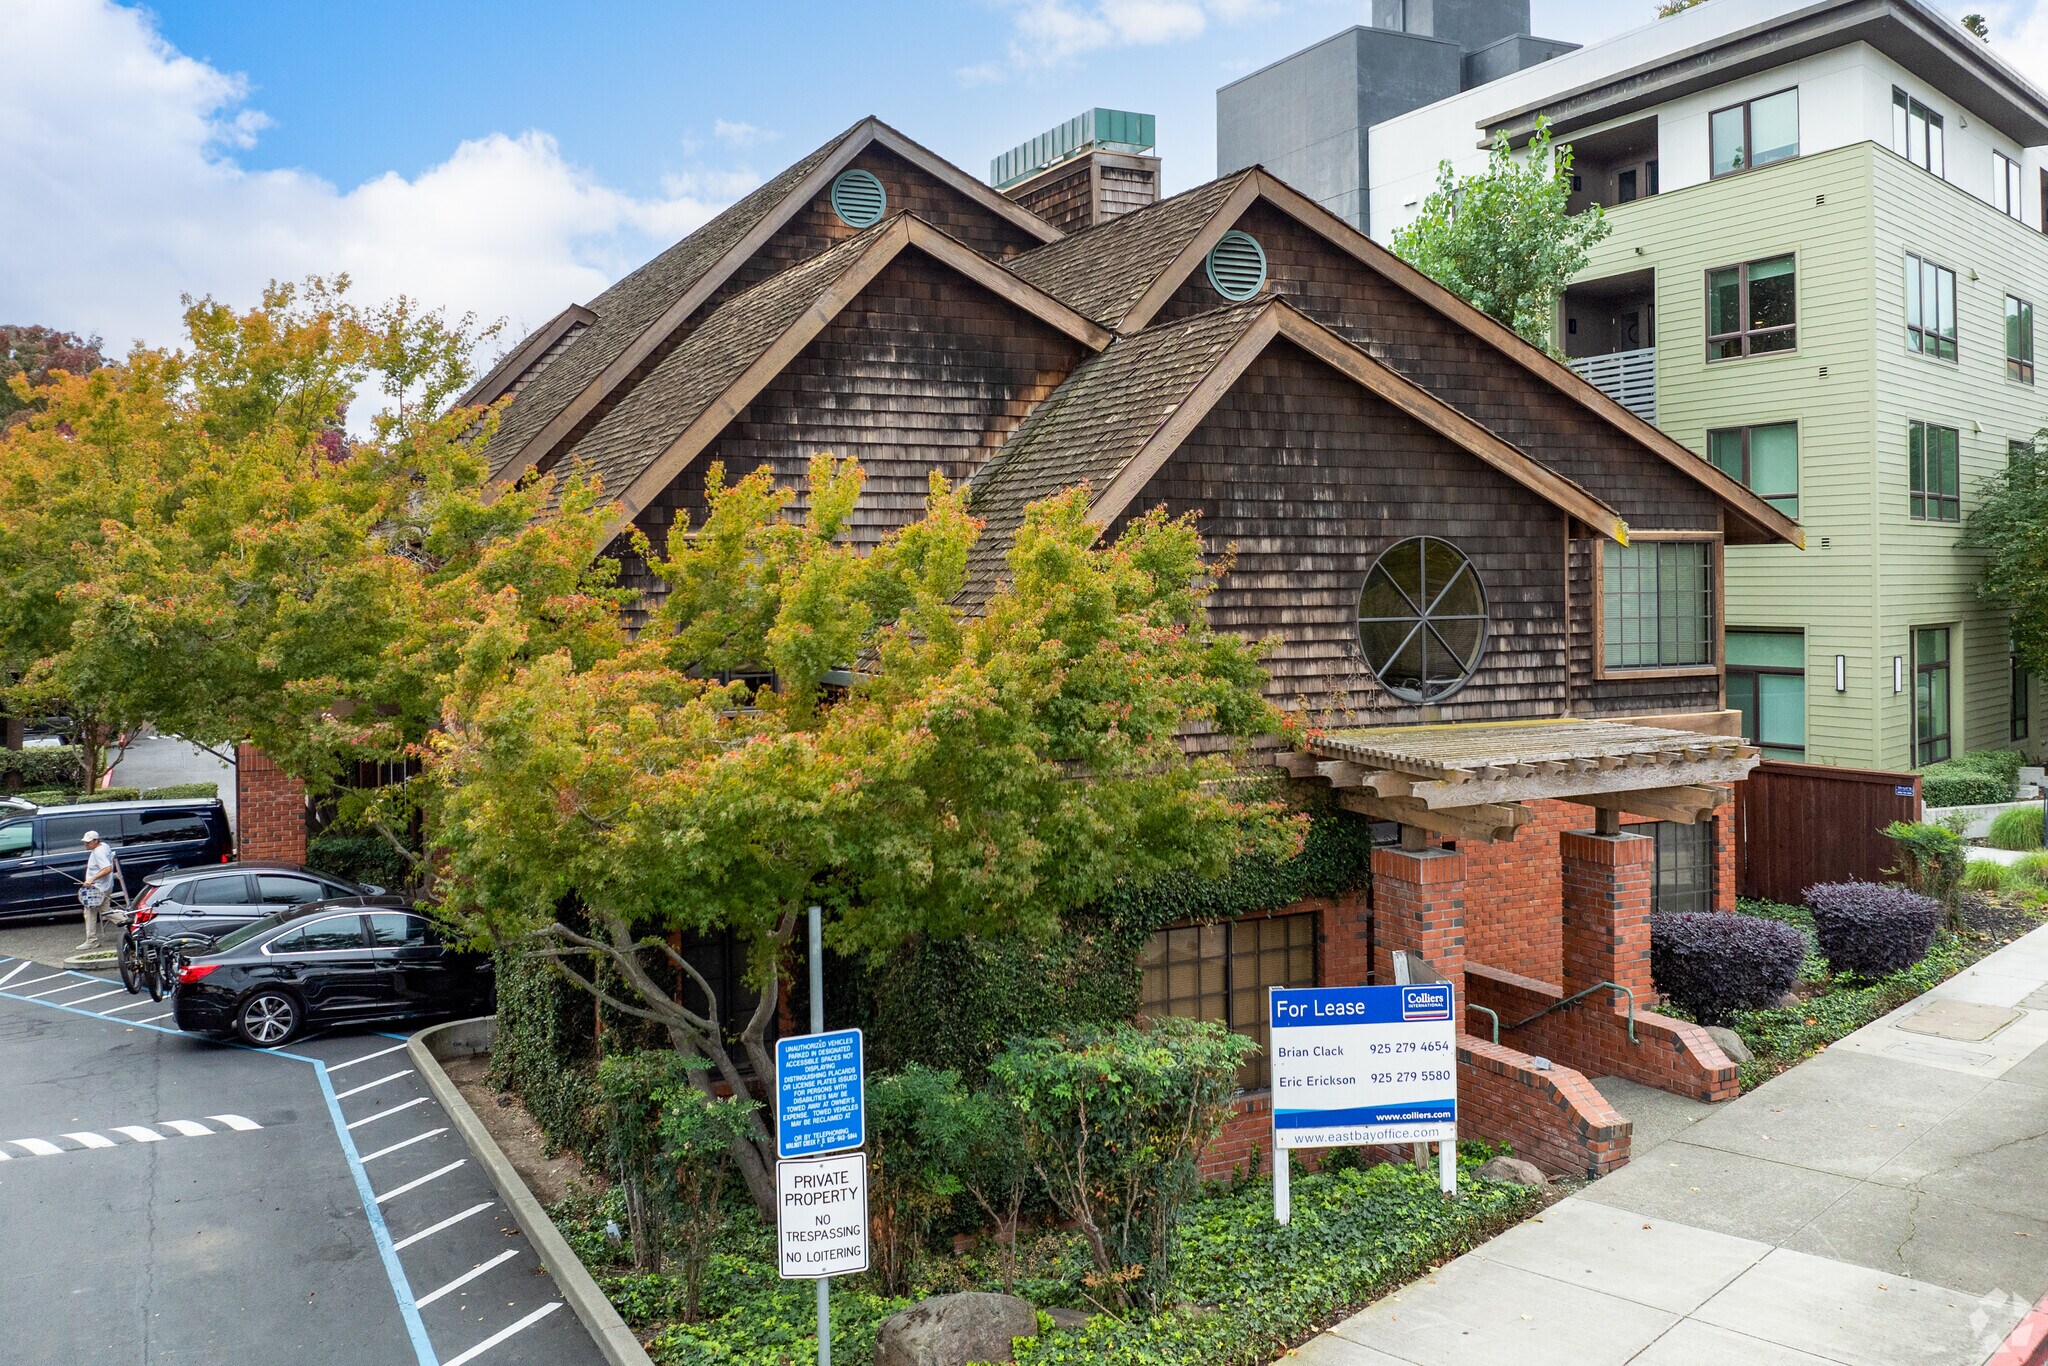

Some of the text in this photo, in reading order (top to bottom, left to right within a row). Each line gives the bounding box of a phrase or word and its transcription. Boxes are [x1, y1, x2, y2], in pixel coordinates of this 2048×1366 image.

[1408, 993, 1444, 1003] Colliers
[1277, 1000, 1365, 1017] For Lease
[785, 1038, 853, 1052] UNAUTHORIZED VEHICLES
[818, 1045, 850, 1055] DESIGNATED
[1279, 1041, 1449, 1058] Brian Clack 925 279 4654
[786, 1058, 818, 1067] ACCESSIBLE
[821, 1054, 841, 1063] SPACES
[805, 1063, 835, 1072] DISPLAYING
[784, 1067, 855, 1083] DISTINGUISHING PLACARDS
[1280, 1070, 1450, 1087] Eric Erickson 925 279 5580
[793, 1081, 815, 1089] LICENSE
[817, 1077, 836, 1085] PLATES
[807, 1086, 832, 1094] PERSONS
[787, 1105, 805, 1113] TOWED
[831, 1097, 855, 1106] OWNER'S
[794, 1094, 826, 1104] DISABILITIES
[833, 1104, 858, 1113] VEHICLES
[813, 1114, 843, 1124] RECLAIMED
[1376, 1111, 1451, 1121] www.colliers.com
[813, 1128, 849, 1138] TELEPHONING
[1295, 1128, 1439, 1143] www.eastbayoffice.com
[794, 1171, 849, 1189] PRIVATE
[785, 1187, 858, 1206] PROPERTY
[816, 1214, 830, 1226] NO
[786, 1225, 860, 1242] TRESPASSING
[787, 1246, 861, 1263] NO LOITERING
